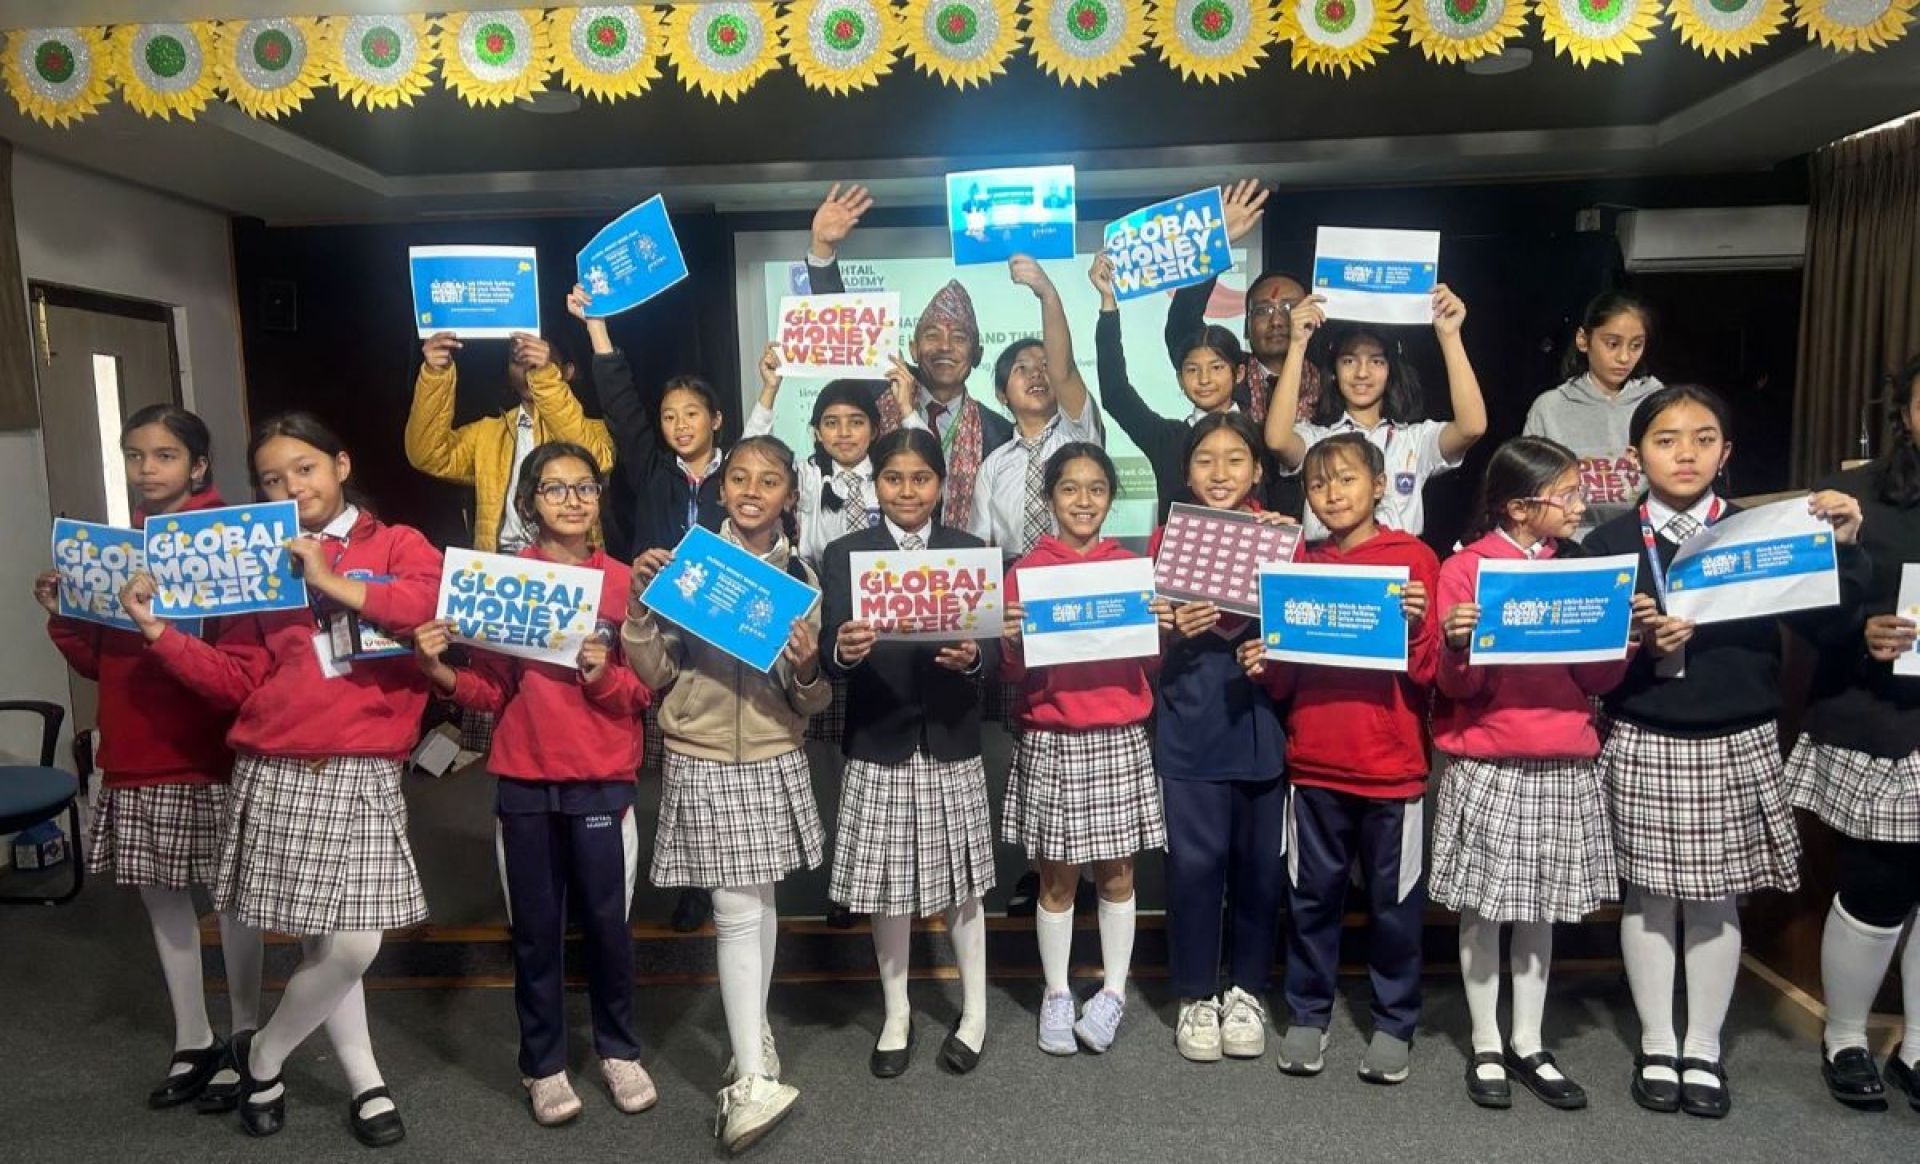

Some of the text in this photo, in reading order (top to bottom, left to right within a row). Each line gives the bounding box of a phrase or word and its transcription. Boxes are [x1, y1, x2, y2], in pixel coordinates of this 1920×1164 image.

[1106, 206, 1221, 250] GLOBAL
[1107, 228, 1212, 270] MONEY
[840, 265, 876, 276] HTAIL
[843, 276, 884, 287] ADEMY
[785, 307, 894, 326] GLOBAL
[783, 325, 883, 345] MONEY
[1579, 472, 1640, 488] NEY
[1590, 489, 1629, 504] EK
[56, 538, 145, 571] GLOB
[150, 521, 292, 559] GLOBAL
[57, 563, 130, 594] MON
[150, 547, 283, 583] MONEY
[451, 569, 592, 610] GLOBAL
[859, 568, 997, 594] GLOBAL
[447, 593, 578, 630] MONEY
[860, 590, 985, 618] MONEY
